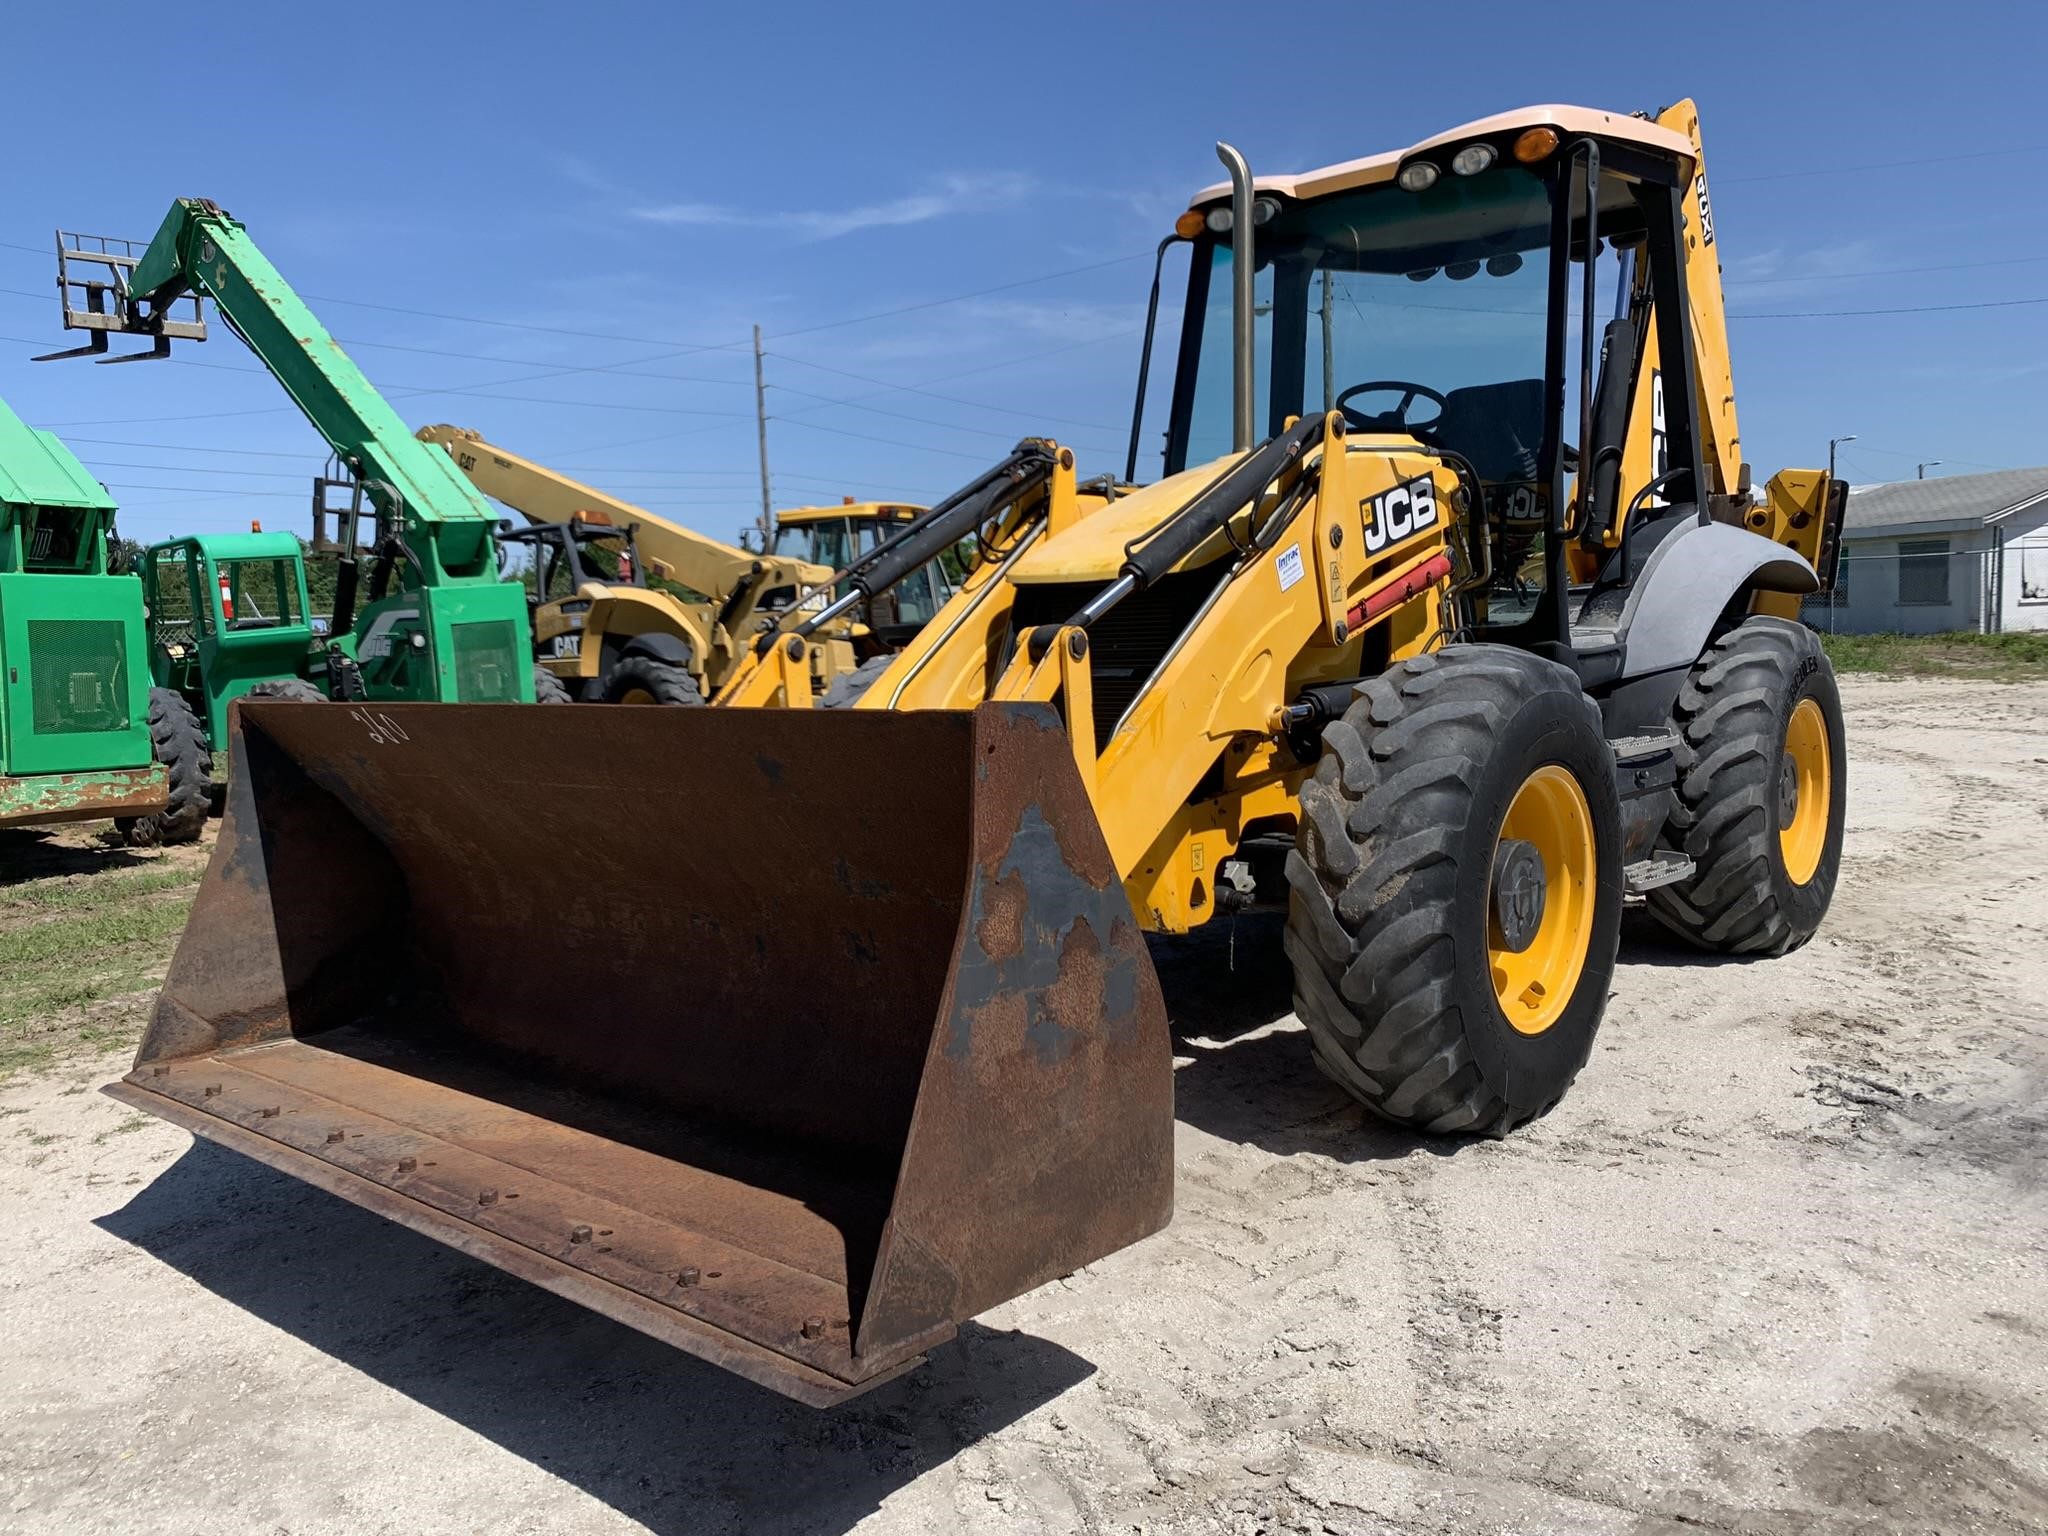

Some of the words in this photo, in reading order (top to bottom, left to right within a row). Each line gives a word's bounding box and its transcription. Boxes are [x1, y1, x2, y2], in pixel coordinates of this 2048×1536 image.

[1697, 175, 1711, 236] 4CX
[460, 452, 476, 472] CAT
[1364, 477, 1436, 551] JCB
[554, 635, 579, 657] CAT
